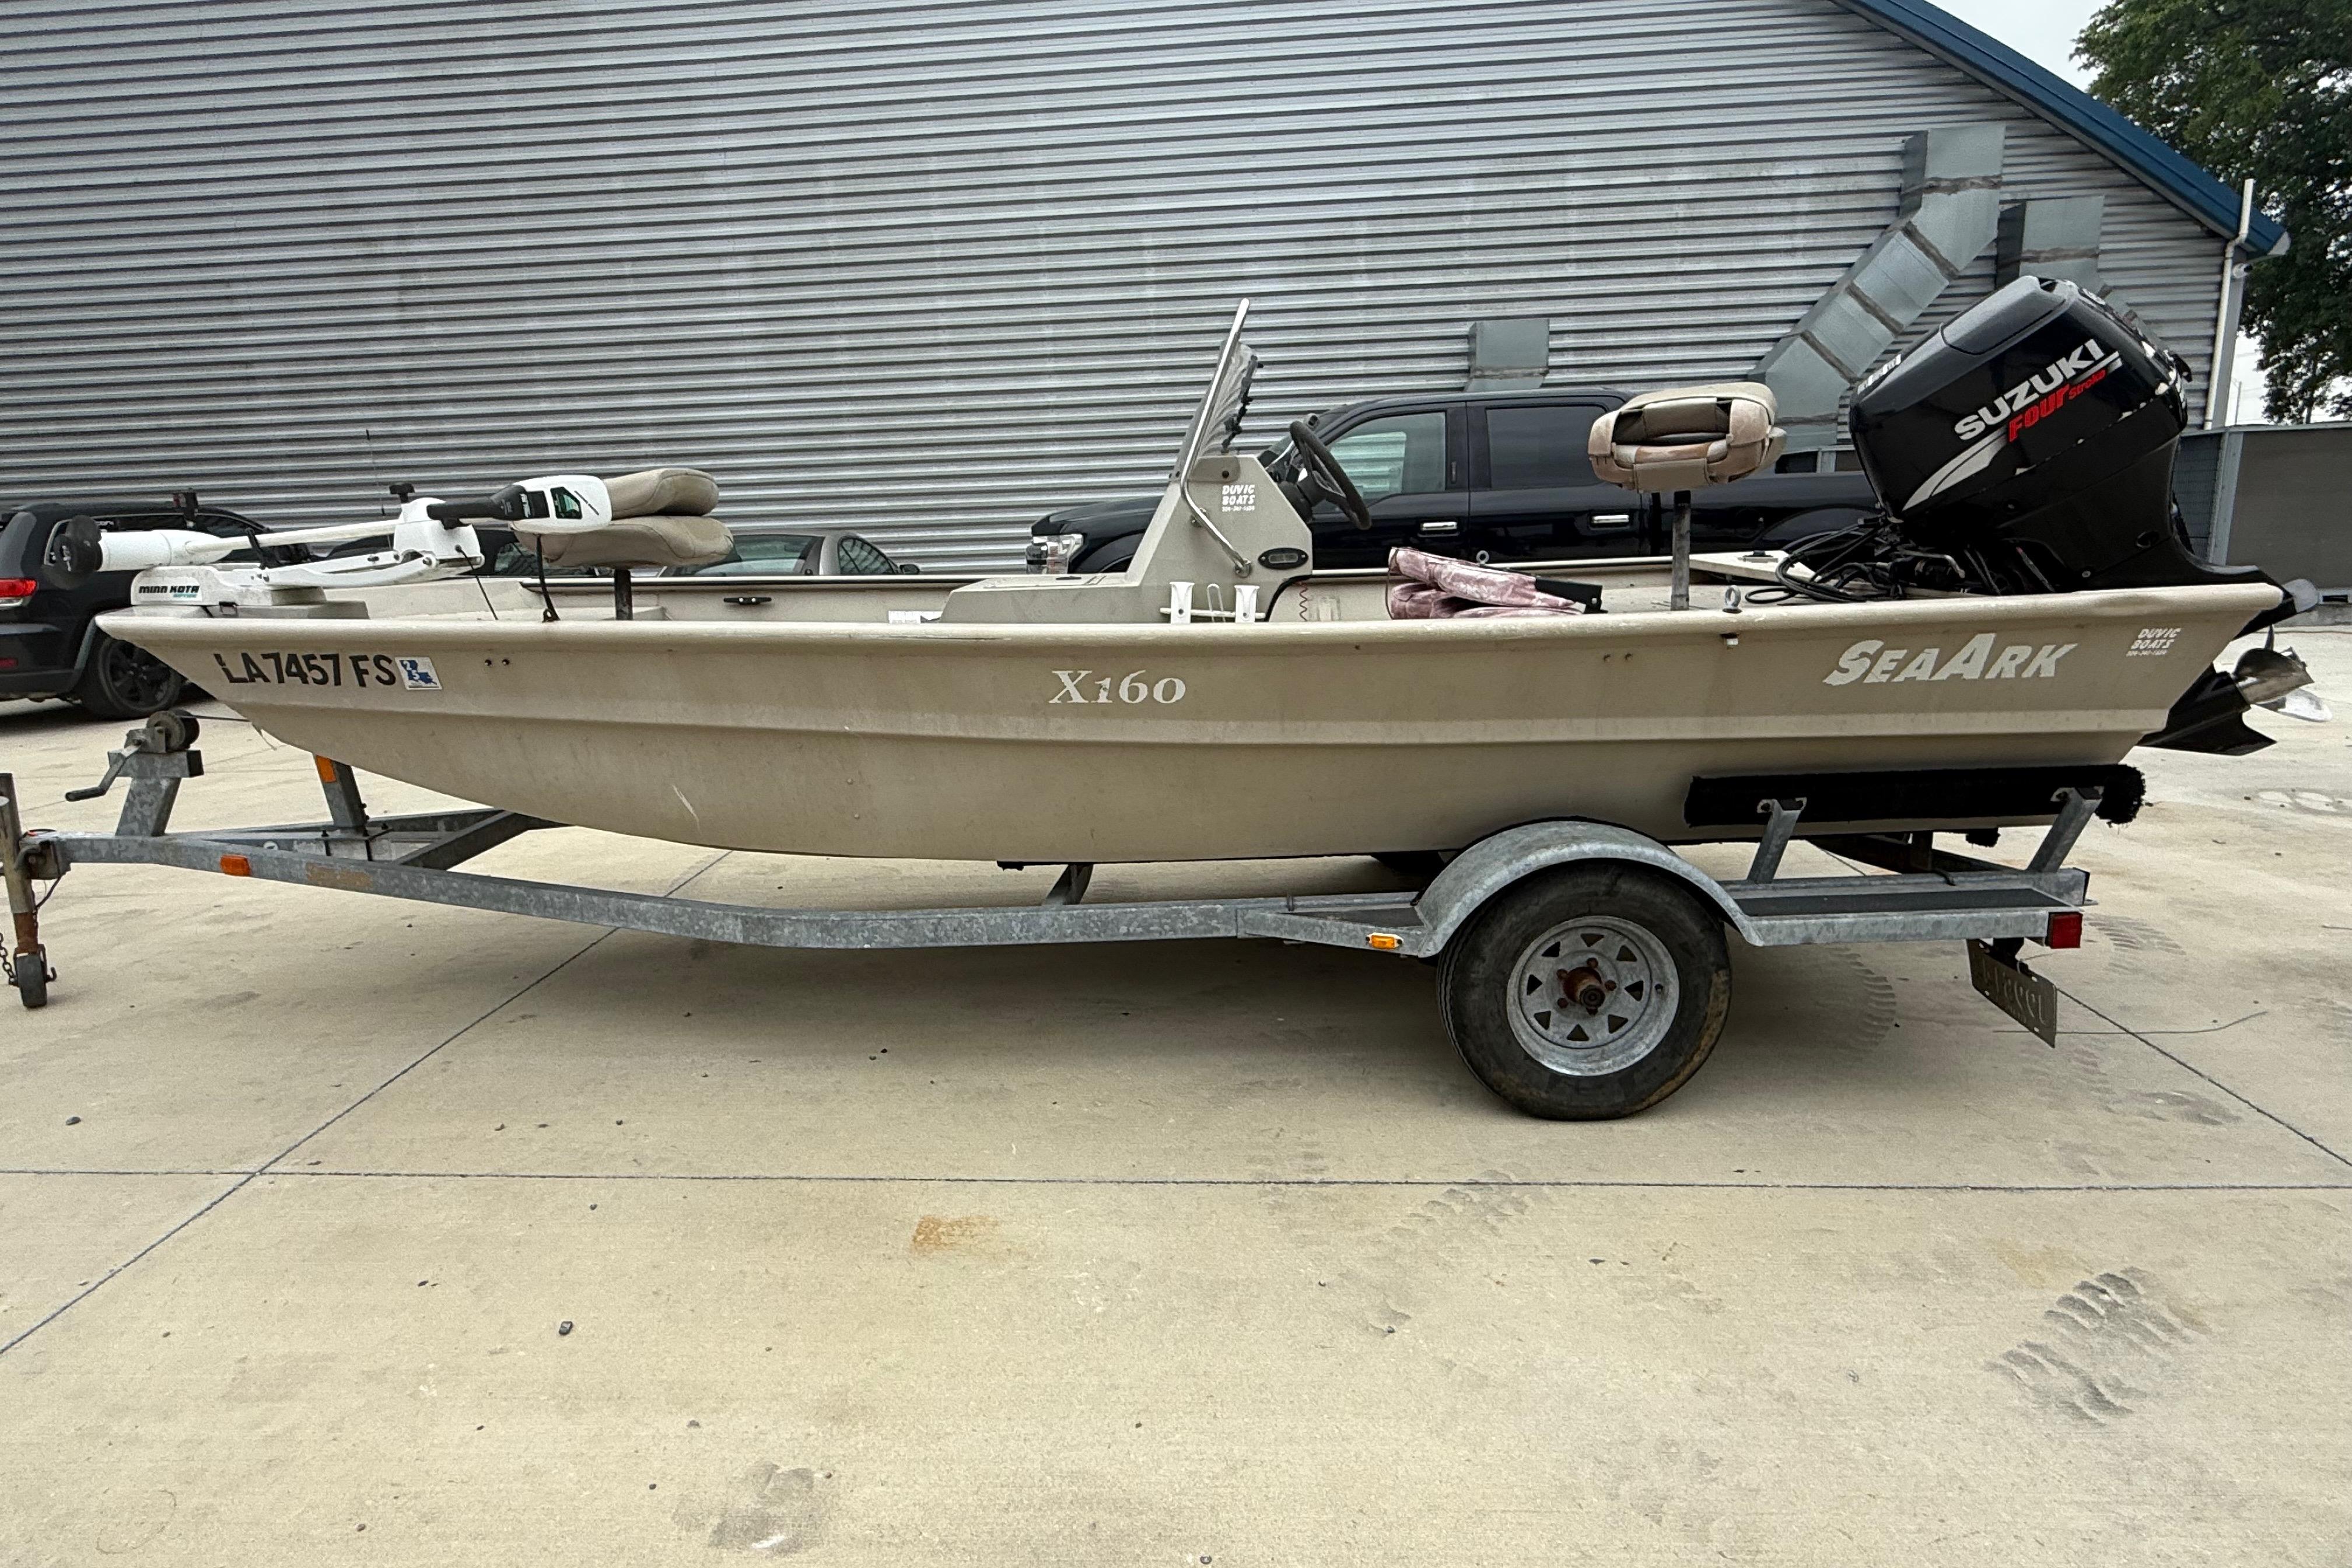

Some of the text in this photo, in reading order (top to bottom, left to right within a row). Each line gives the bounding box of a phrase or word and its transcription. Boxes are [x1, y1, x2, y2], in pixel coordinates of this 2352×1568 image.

[1954, 338, 2106, 441] SUZUKI
[1222, 484, 1255, 495] DUVIC
[1222, 495, 1255, 505] BOATS
[169, 586, 200, 594] KOTA
[2137, 628, 2182, 639] DUVIC
[2130, 639, 2175, 650] BOATS
[349, 654, 397, 688] FS
[1048, 670, 1186, 704] X160
